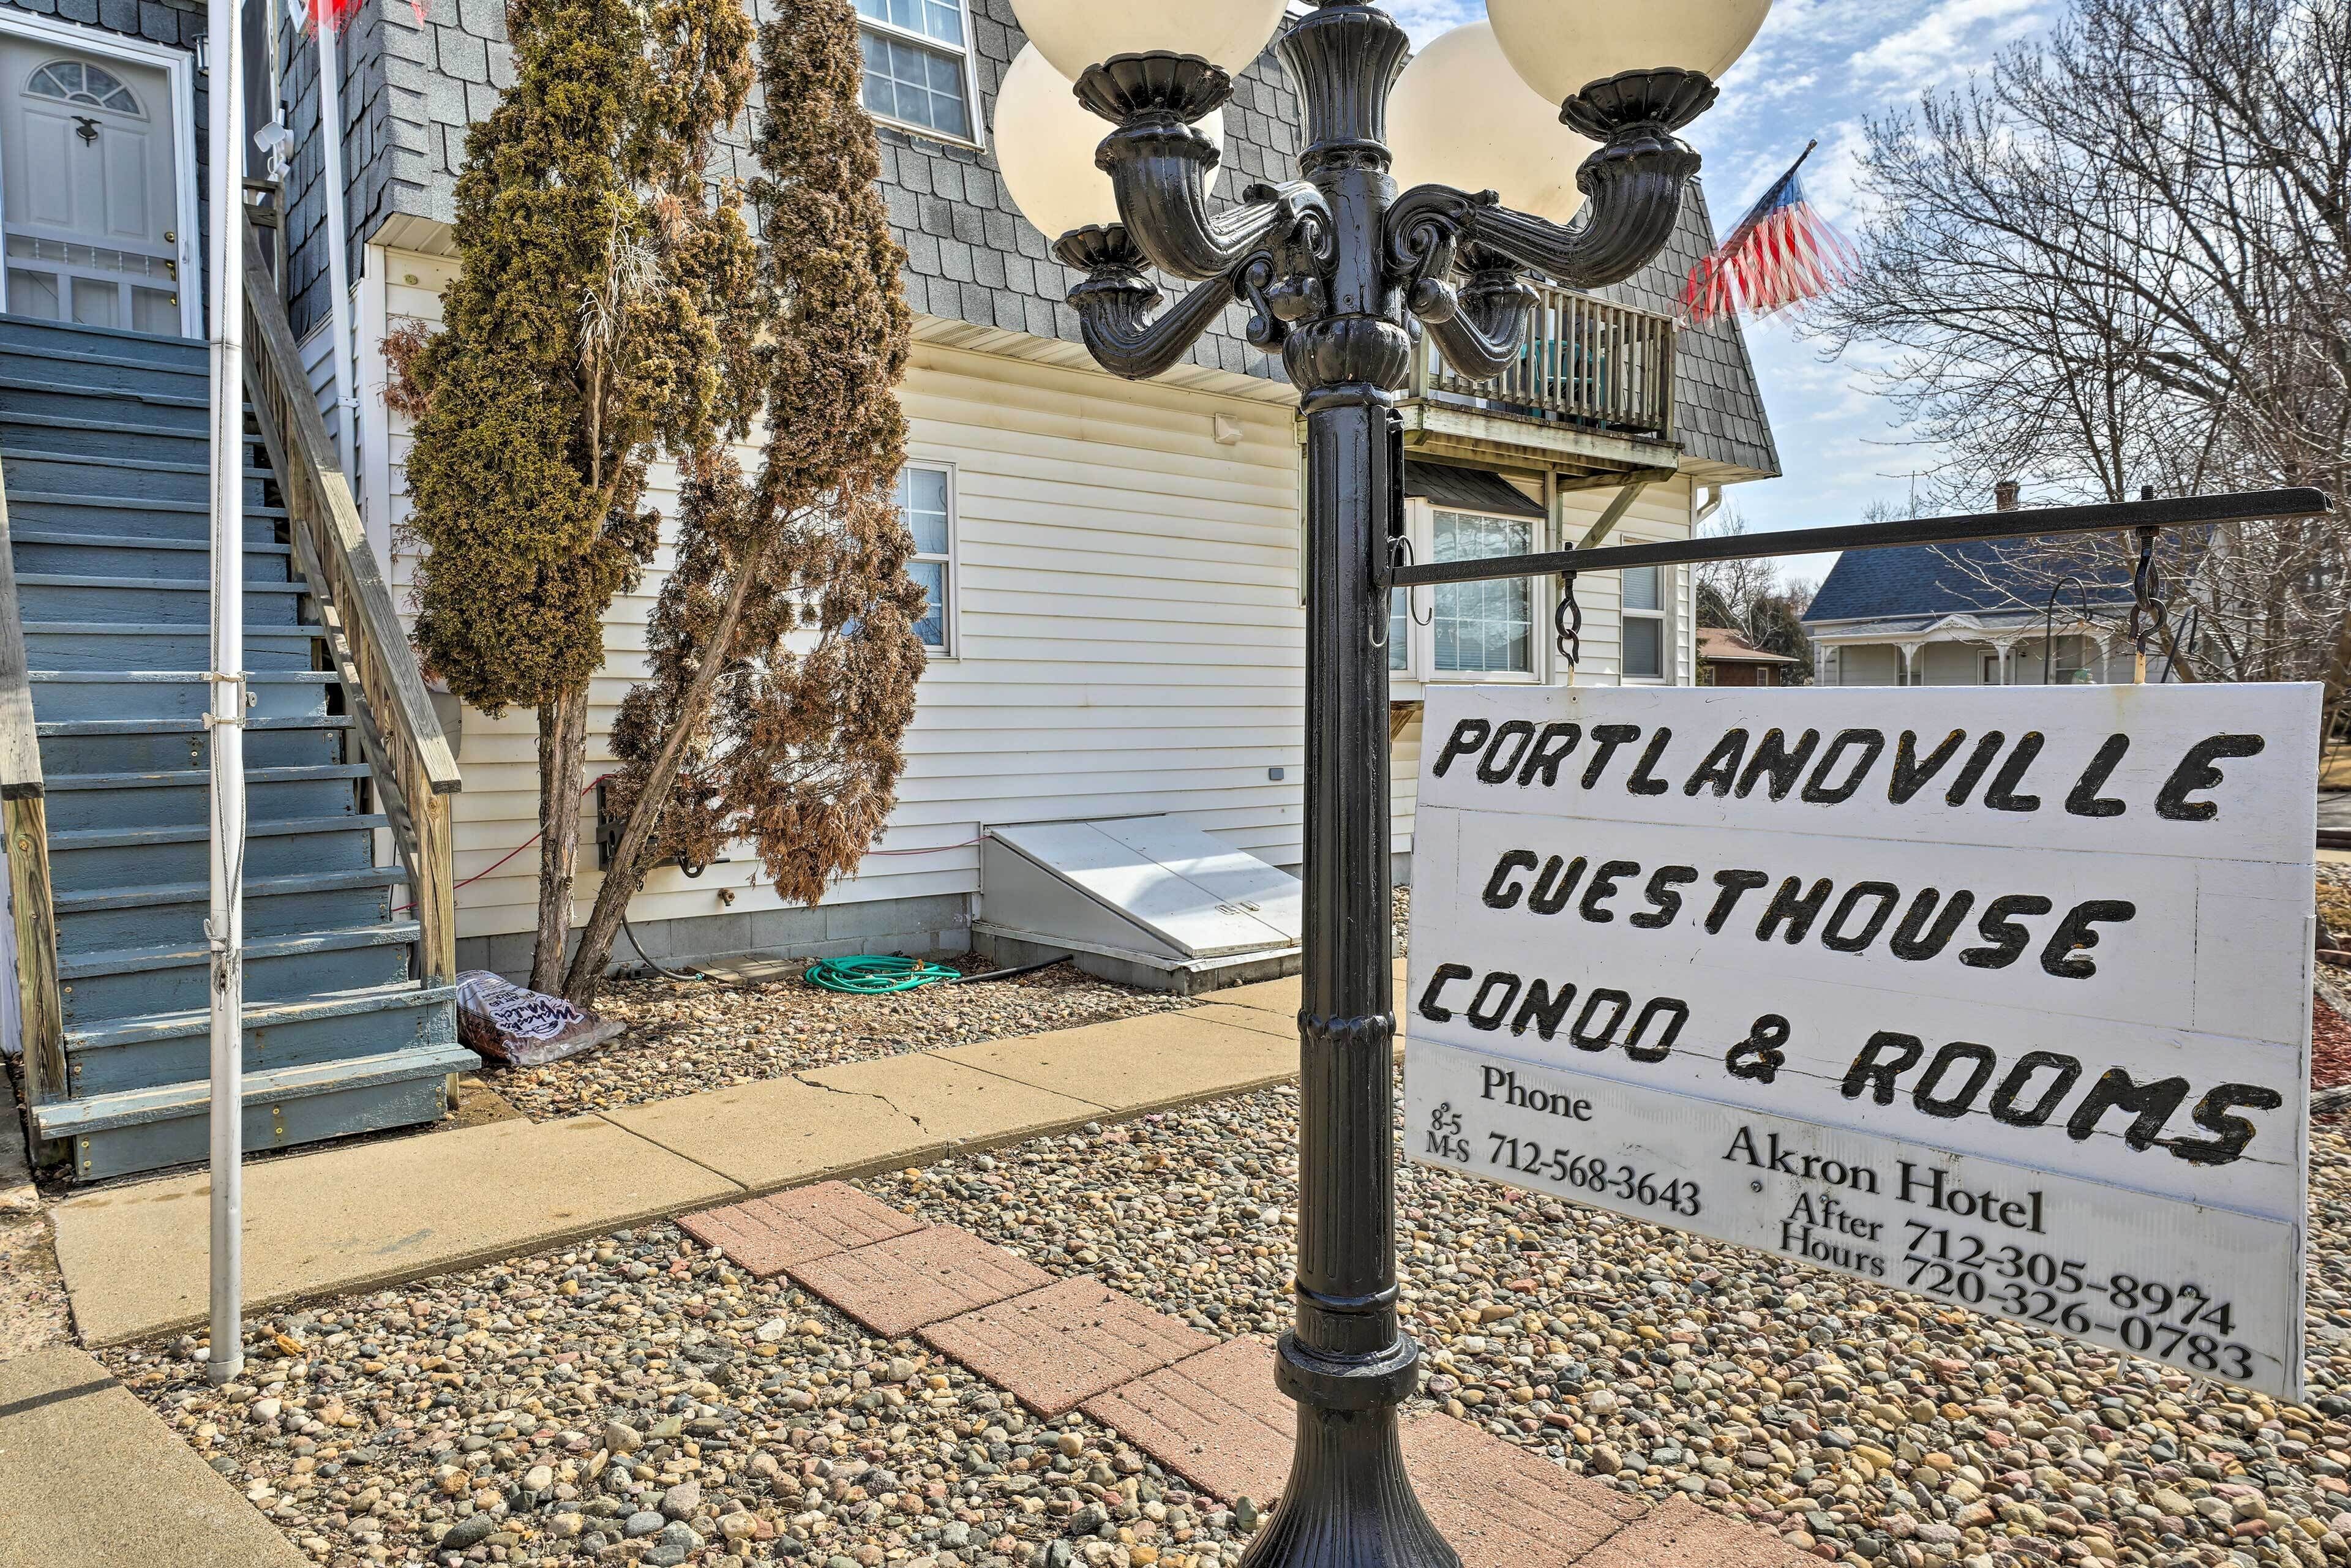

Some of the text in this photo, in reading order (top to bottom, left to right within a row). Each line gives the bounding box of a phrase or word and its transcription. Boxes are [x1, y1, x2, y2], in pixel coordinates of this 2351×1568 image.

[1433, 718, 2265, 822] PORTLANDVILLE
[1482, 849, 2137, 980] GUESTHOUSE
[1418, 962, 2282, 1166] CONDO & ROOMS
[1480, 1065, 1592, 1122] Phone
[1426, 1130, 1469, 1163] M-S
[1432, 1109, 1463, 1135] 8-5
[1488, 1131, 1701, 1217] 712-568-3643
[1722, 1125, 2047, 1235] Akron Hotel
[1787, 1192, 1884, 1242] After
[1778, 1219, 1884, 1277] Hours
[1903, 1219, 2236, 1336] 712-305-8974
[1902, 1254, 2254, 1379] 720-326-0783
